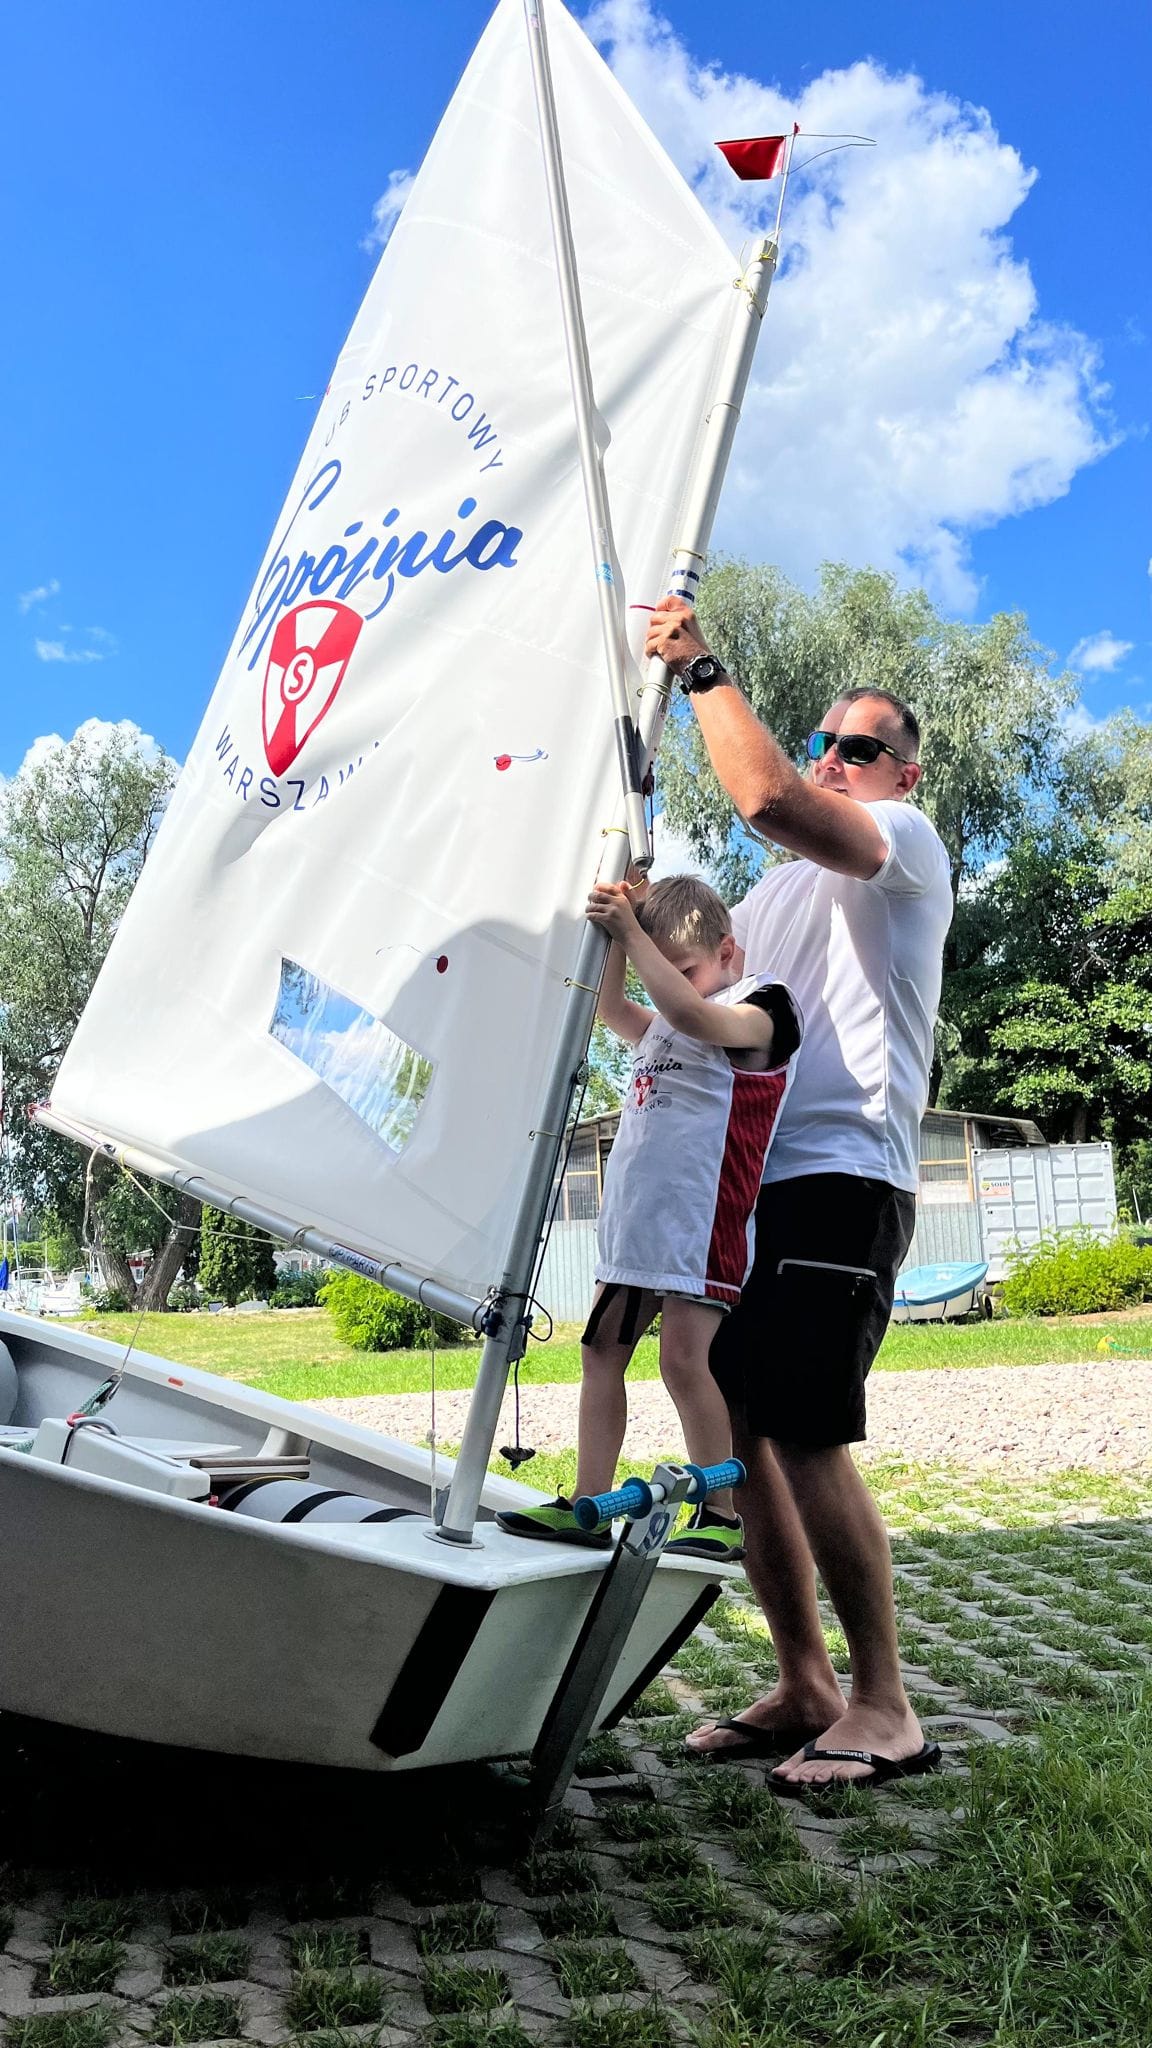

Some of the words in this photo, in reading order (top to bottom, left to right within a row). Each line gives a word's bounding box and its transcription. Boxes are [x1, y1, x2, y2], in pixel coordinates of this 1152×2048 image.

[362, 363, 504, 473] SPORTOWY
[288, 659, 308, 694] S
[215, 723, 381, 811] WARSZA
